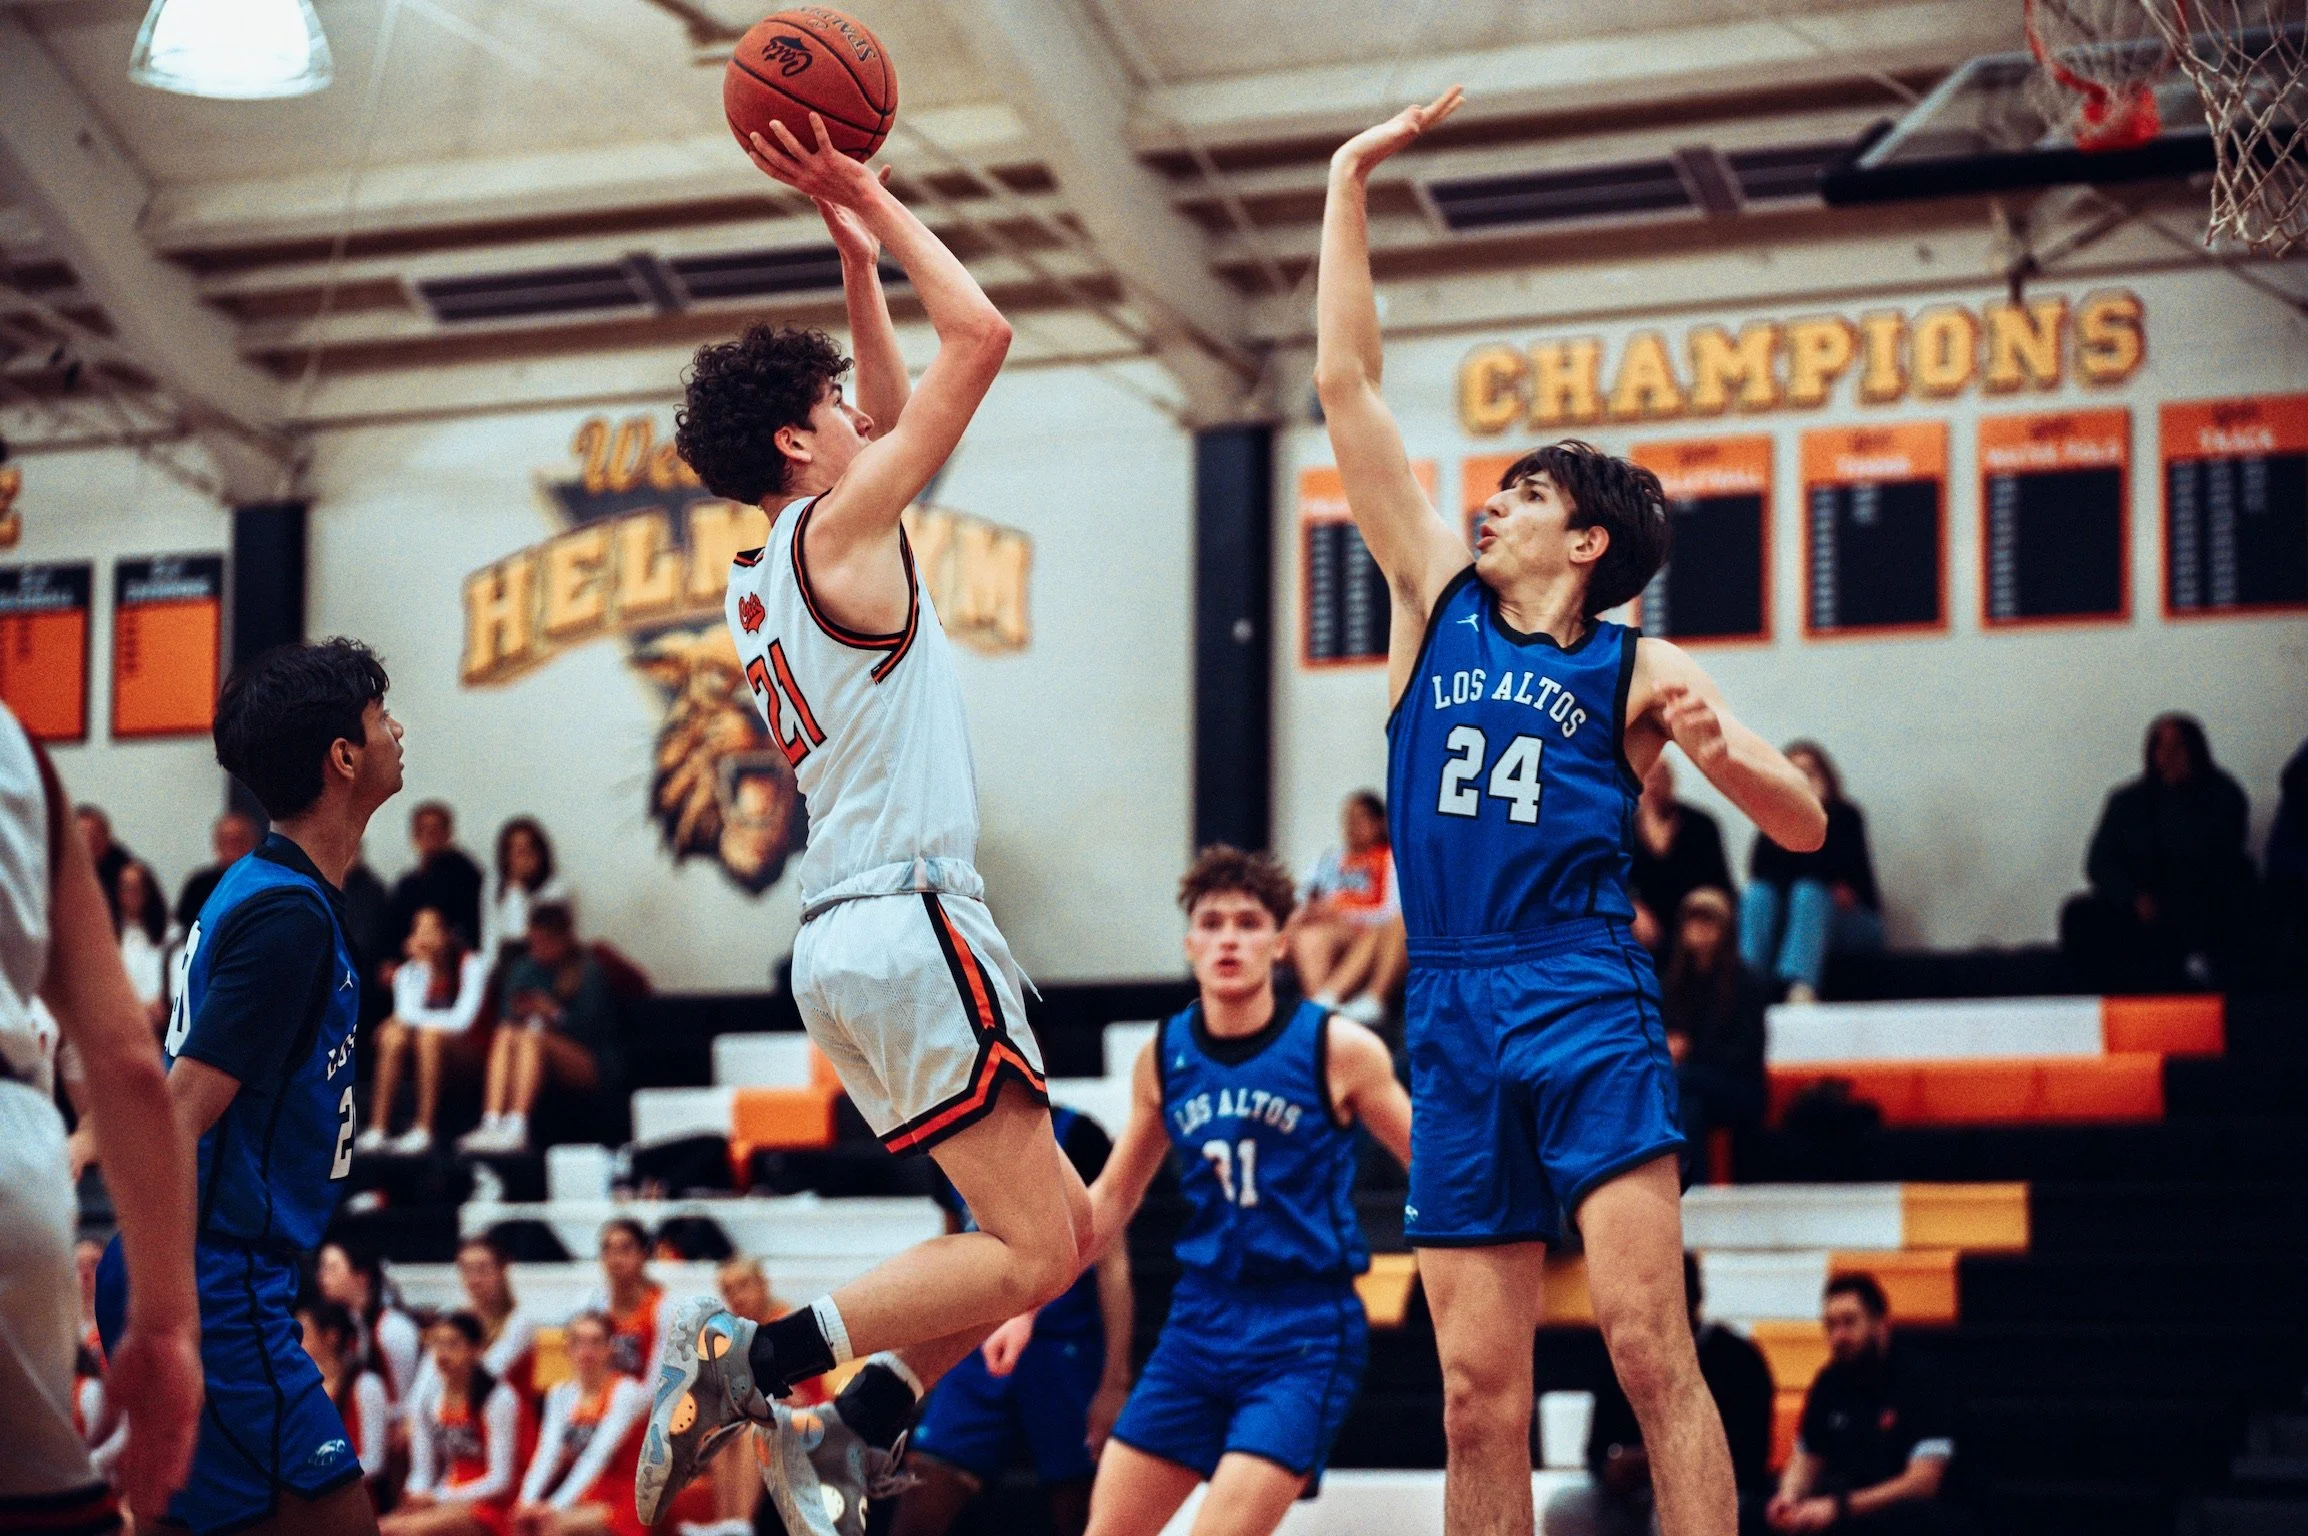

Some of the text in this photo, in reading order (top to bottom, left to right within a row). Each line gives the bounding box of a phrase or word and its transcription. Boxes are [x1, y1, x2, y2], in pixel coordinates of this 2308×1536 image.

[1458, 288, 2146, 437] CHAMPIONS
[746, 637, 828, 768] 21
[1431, 668, 1588, 738] LOS ALTOS
[1437, 724, 1544, 825] 24
[1174, 1087, 1303, 1138] LOS ALTOS
